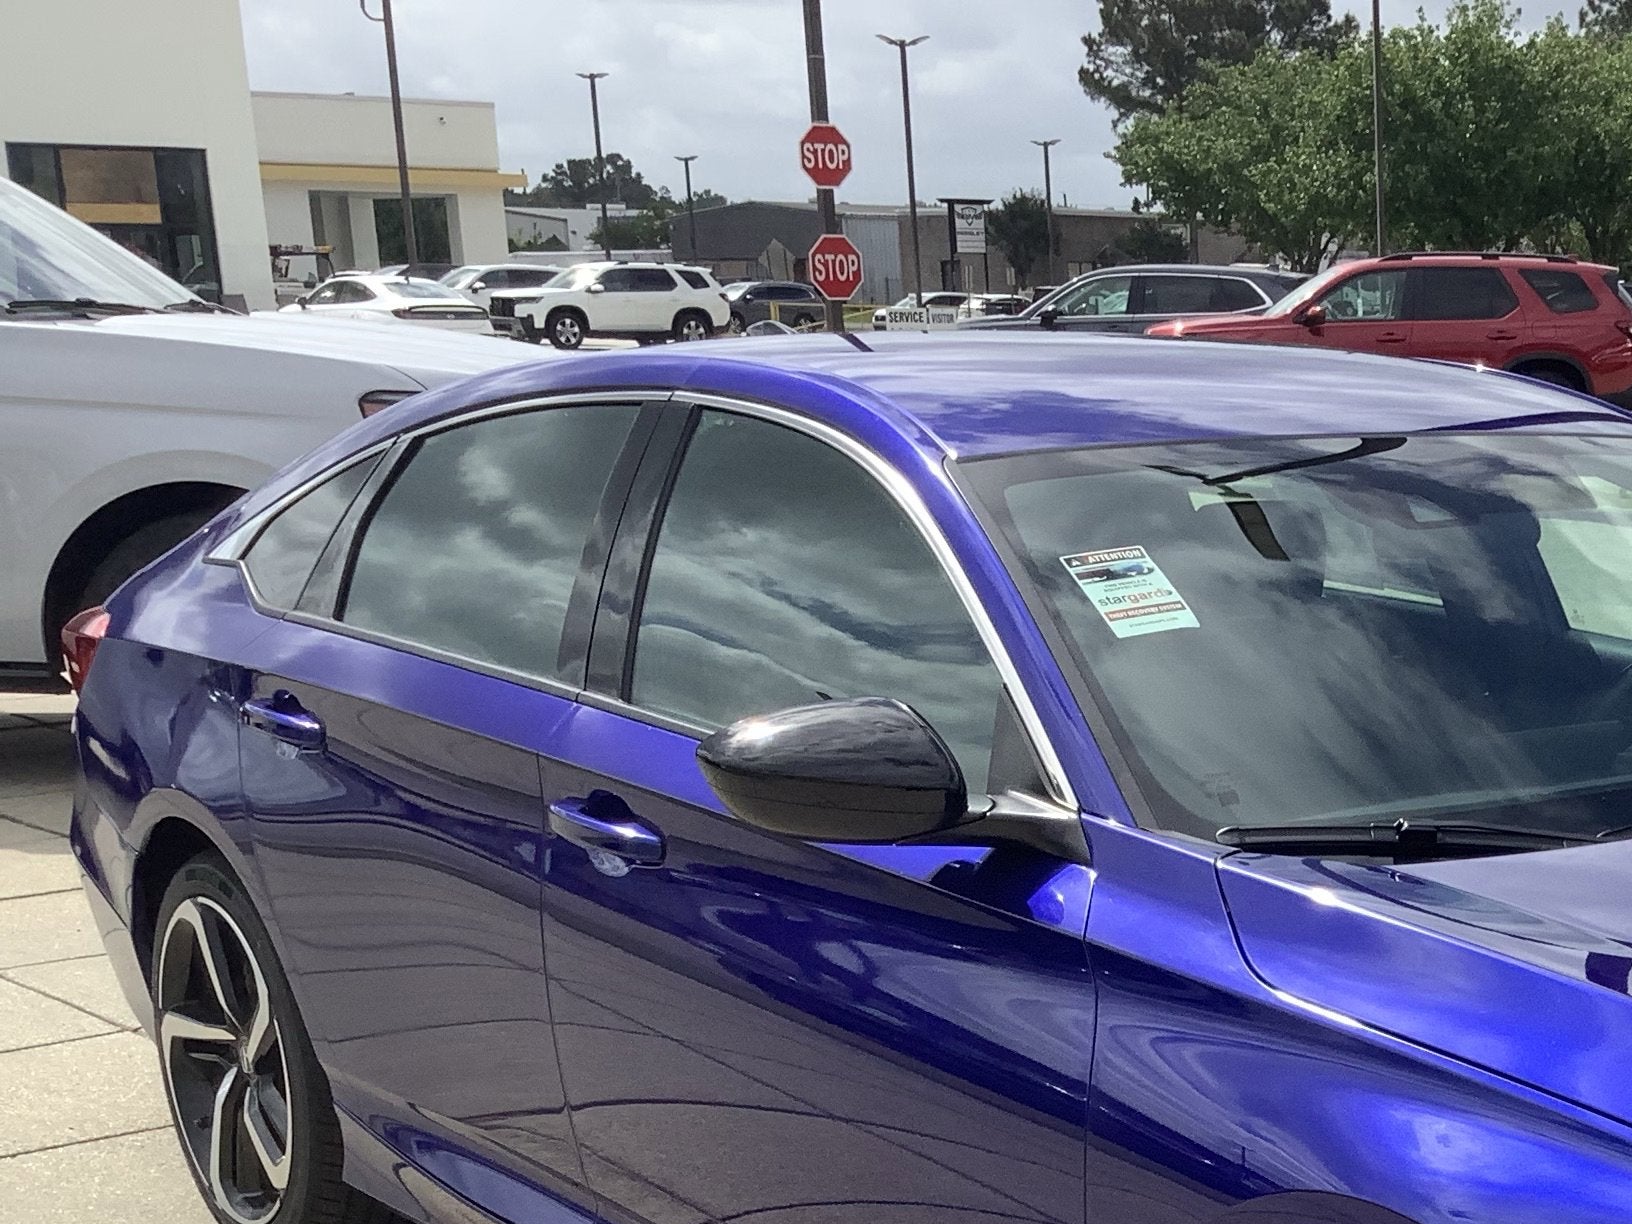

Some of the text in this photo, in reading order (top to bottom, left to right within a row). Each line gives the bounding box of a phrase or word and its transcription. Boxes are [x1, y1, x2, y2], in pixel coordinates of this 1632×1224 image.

[803, 142, 849, 170] STOP
[814, 253, 859, 282] STOP
[888, 311, 924, 323] SERVICE
[931, 313, 955, 324] VISITOR
[1088, 550, 1141, 563] ATTENTION
[1108, 603, 1182, 619] THEFT RECOVERY SYSTEM
